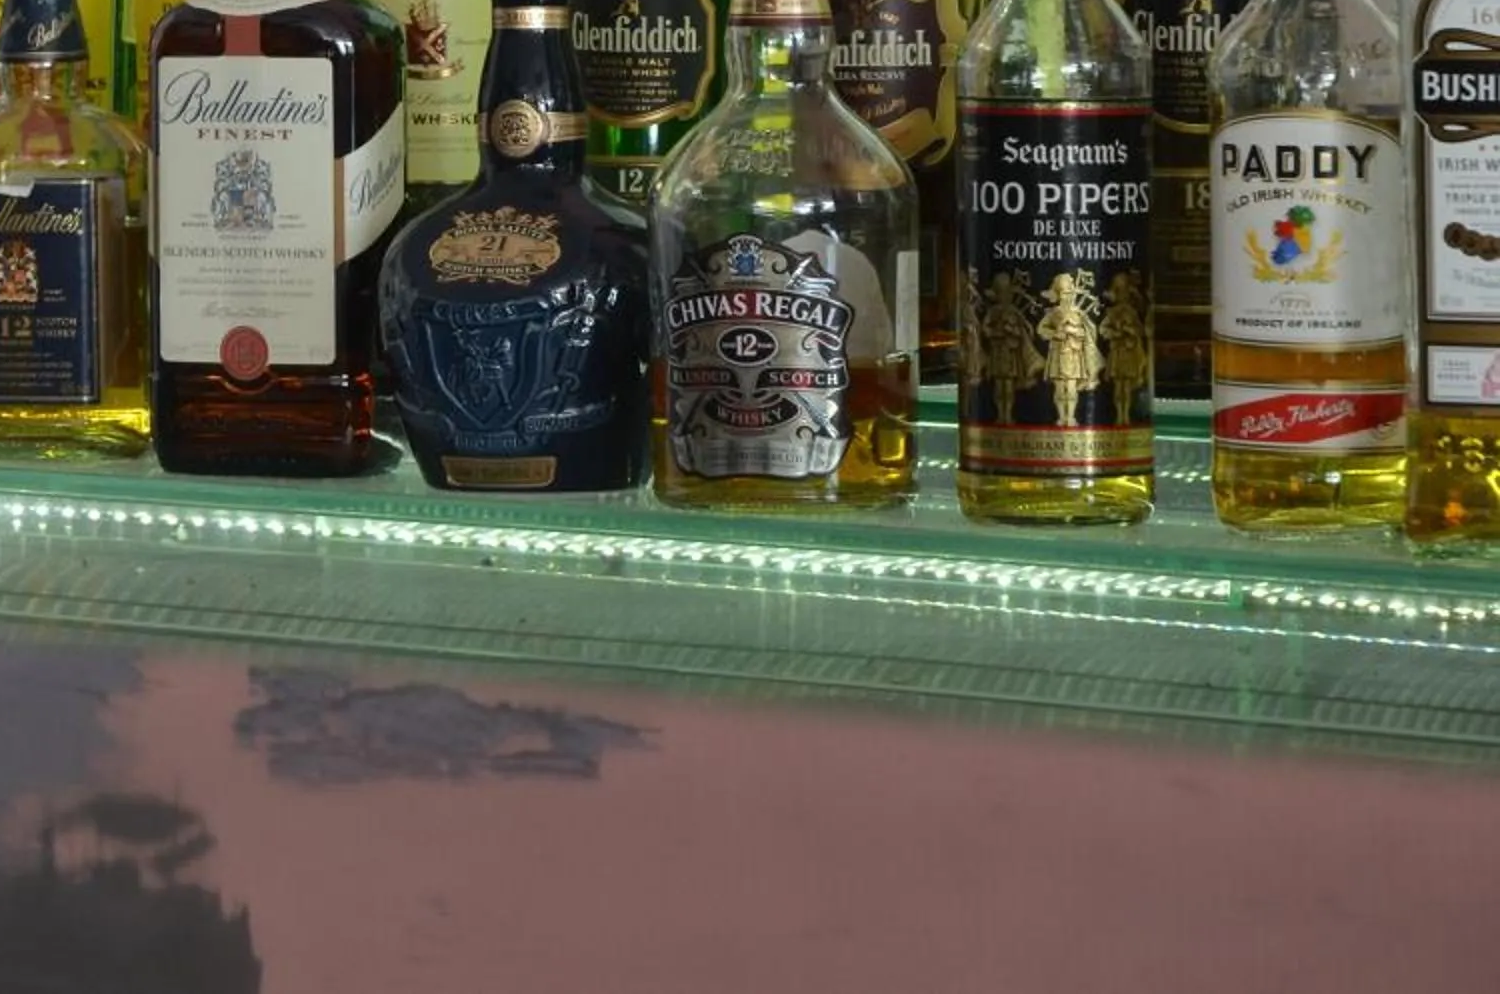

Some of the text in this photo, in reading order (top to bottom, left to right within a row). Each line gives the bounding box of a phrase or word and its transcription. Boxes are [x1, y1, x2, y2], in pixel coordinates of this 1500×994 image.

[571, 11, 697, 54] Glenfiddich
[637, 58, 671, 66] MALT
[164, 70, 328, 127] Ballantine's
[198, 127, 293, 141] FINEST
[1003, 136, 1128, 171] Seagram's
[1221, 143, 1377, 183] PADDY
[618, 169, 644, 193] 12
[973, 180, 1150, 216] 100 PIPERS
[1033, 219, 1102, 238] DE LUXE
[480, 235, 508, 251] 21
[994, 241, 1136, 262] SCOTCH WHISKY
[669, 292, 840, 332] CHIVAS REGAL
[736, 334, 756, 357] 12
[769, 371, 839, 386] SCOTCH
[716, 405, 784, 423] WHISKY
